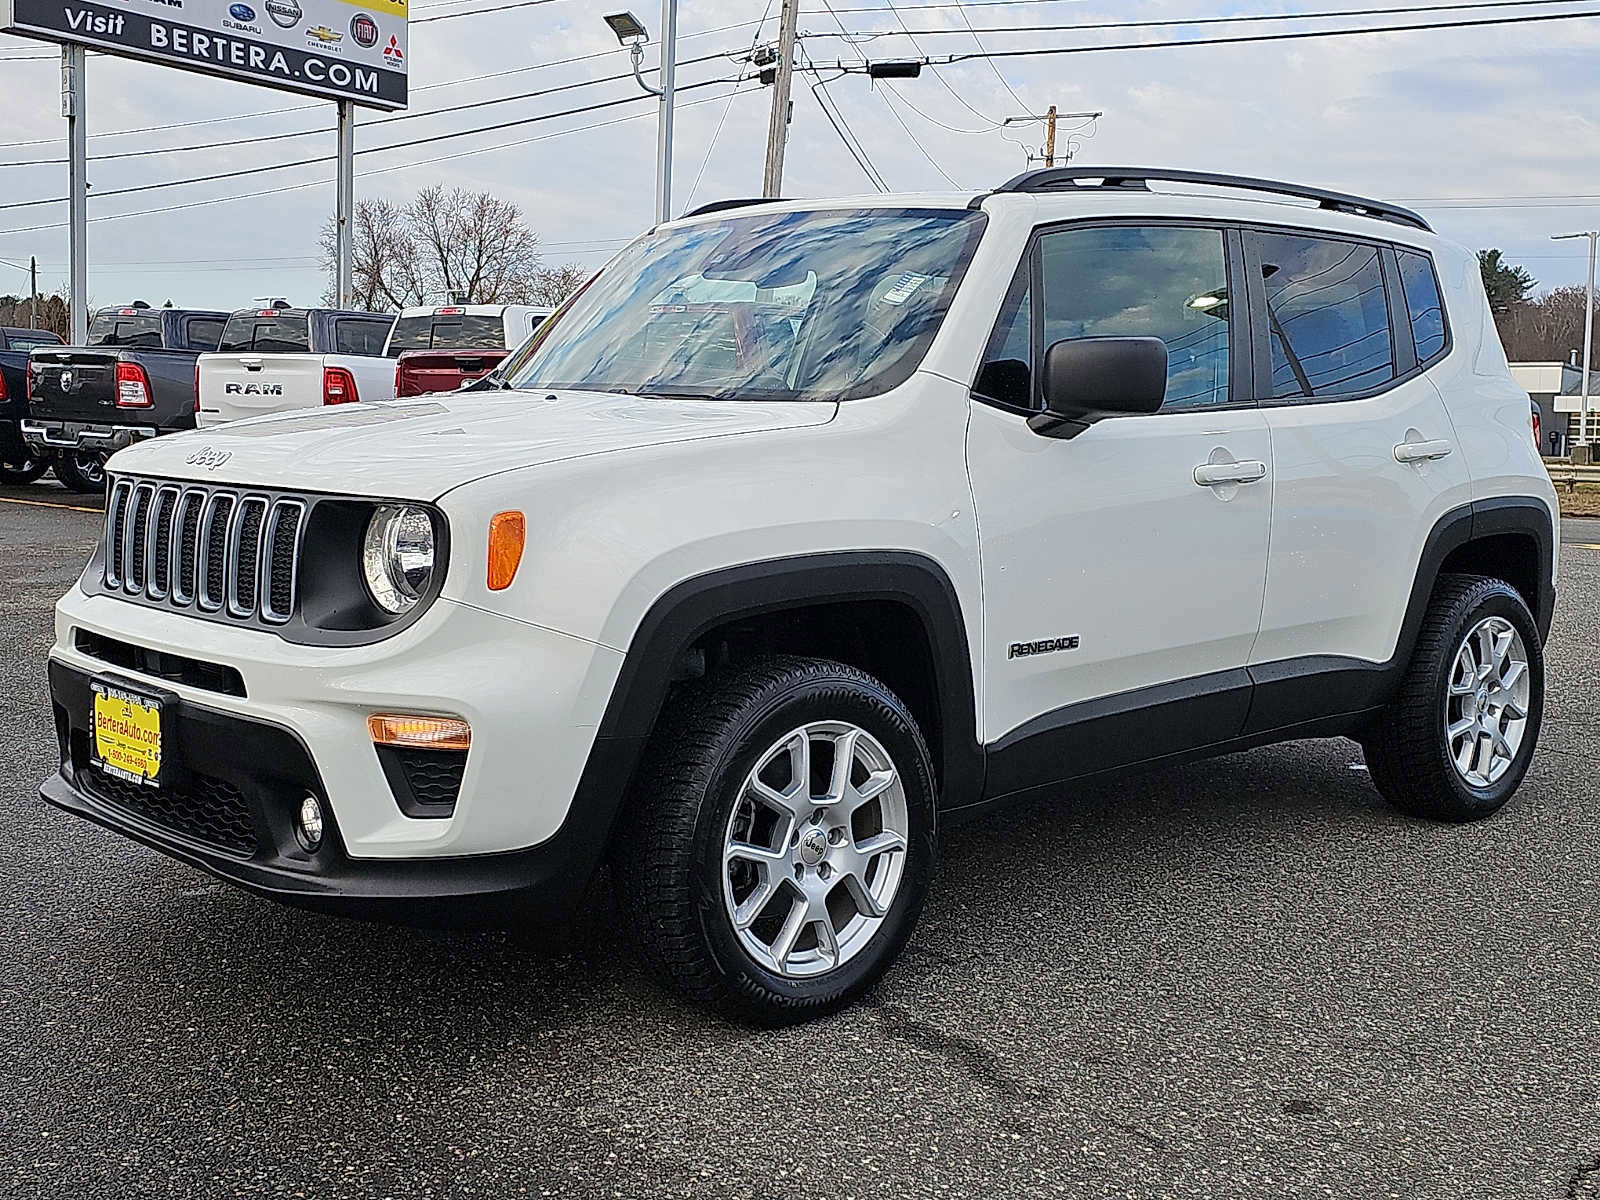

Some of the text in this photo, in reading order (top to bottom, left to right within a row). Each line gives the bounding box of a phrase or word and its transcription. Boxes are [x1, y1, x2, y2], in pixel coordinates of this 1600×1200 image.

[268, 3, 299, 16] NISSAN
[222, 19, 262, 34] SUBARU
[357, 22, 373, 39] FIAT
[65, 8, 378, 93] Visit BERTERA.COM
[307, 40, 342, 53] CHEVROLET
[225, 383, 282, 395] RAM
[185, 444, 233, 471] Jeep
[1008, 635, 1080, 659] RENEGADE
[97, 711, 160, 745] BerteraAuto.com
[804, 837, 824, 856] Jeep
